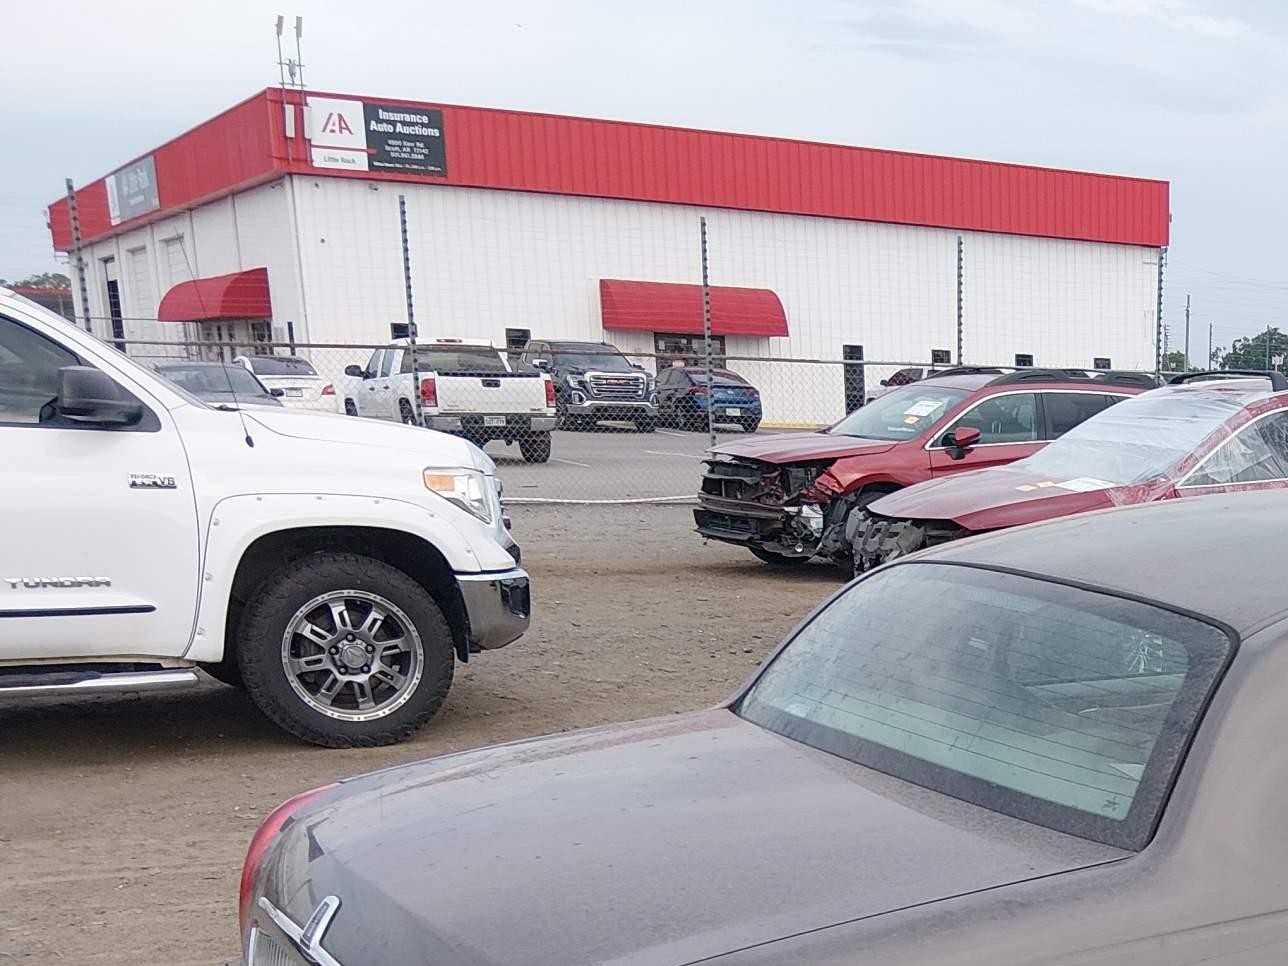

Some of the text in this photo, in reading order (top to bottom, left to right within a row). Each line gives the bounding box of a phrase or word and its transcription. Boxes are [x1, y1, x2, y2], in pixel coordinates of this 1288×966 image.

[378, 109, 429, 124] Insurance
[369, 120, 440, 137] Auto Auctions
[4, 576, 112, 589] TUNDRA
